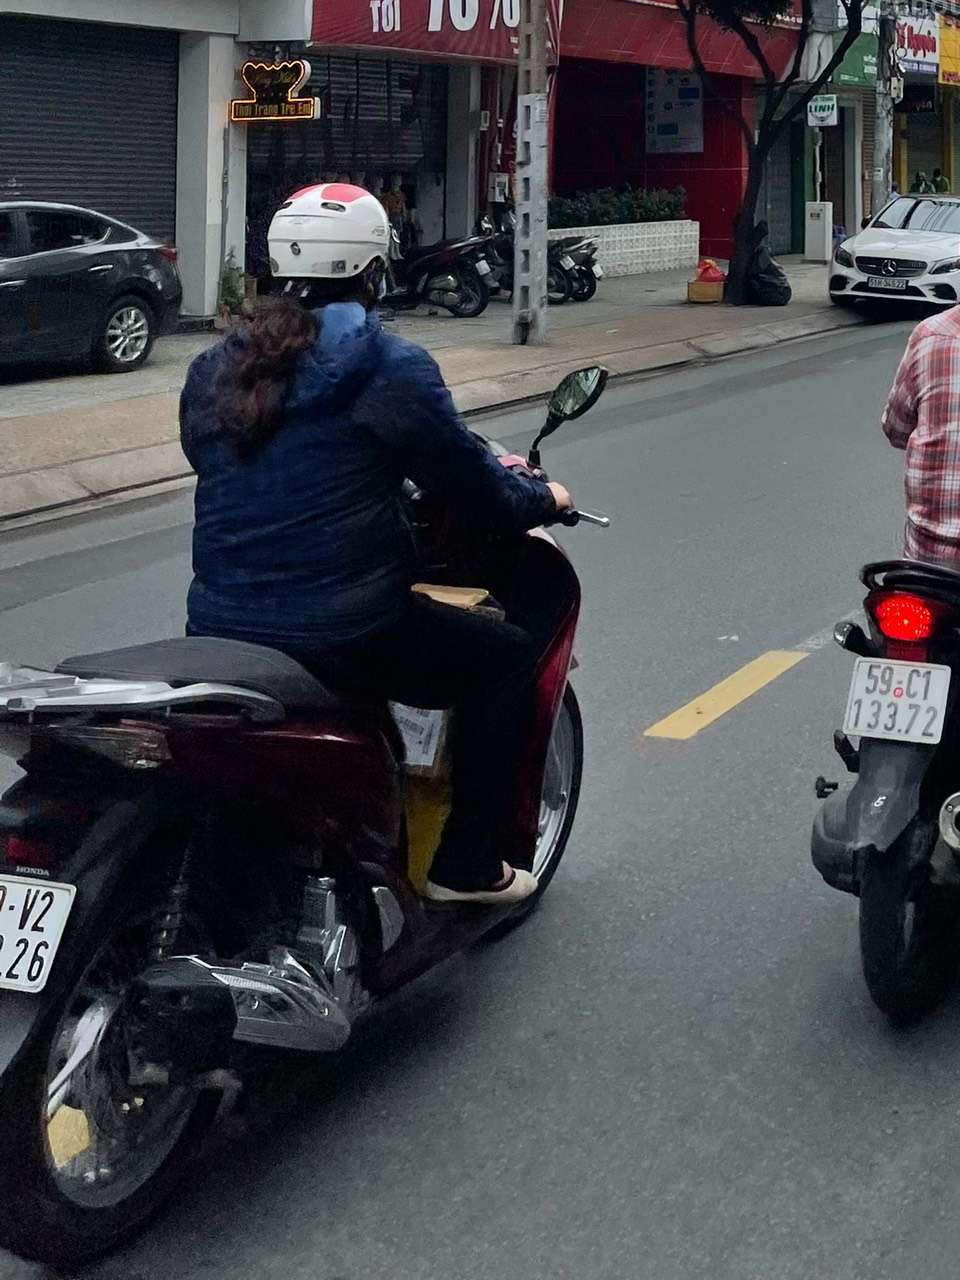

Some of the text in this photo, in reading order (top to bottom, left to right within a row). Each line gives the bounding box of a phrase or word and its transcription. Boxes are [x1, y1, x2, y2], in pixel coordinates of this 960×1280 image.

[809, 104, 835, 112] LINH
[865, 664, 932, 701] 59-C1
[854, 699, 939, 737] 133.72
[16, 865, 50, 877] HONDA
